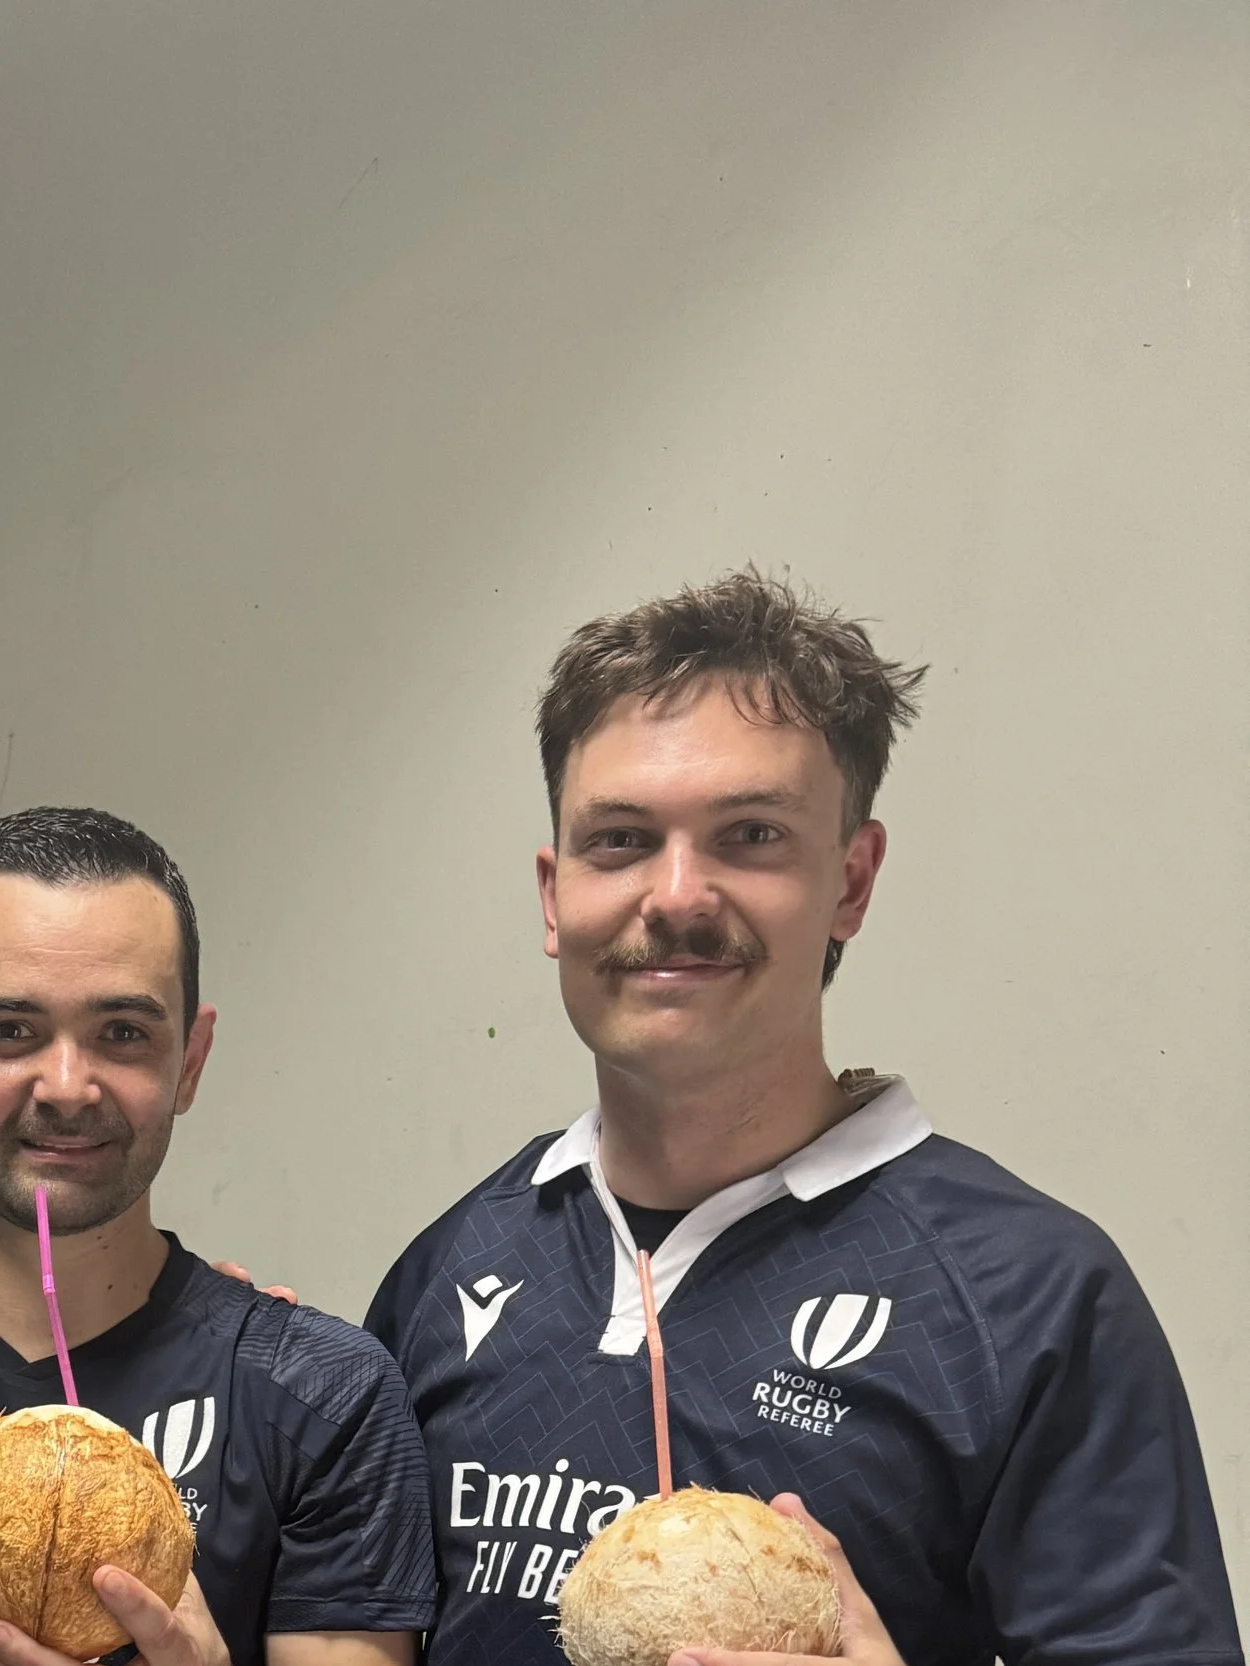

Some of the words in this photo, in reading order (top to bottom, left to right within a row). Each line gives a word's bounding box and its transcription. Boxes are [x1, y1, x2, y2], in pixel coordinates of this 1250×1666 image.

[752, 1382, 852, 1423] RUGBY
[773, 1369, 842, 1399] WORLD
[757, 1405, 835, 1436] REFEREE
[450, 1458, 661, 1537] Emira
[466, 1540, 518, 1594] FLY
